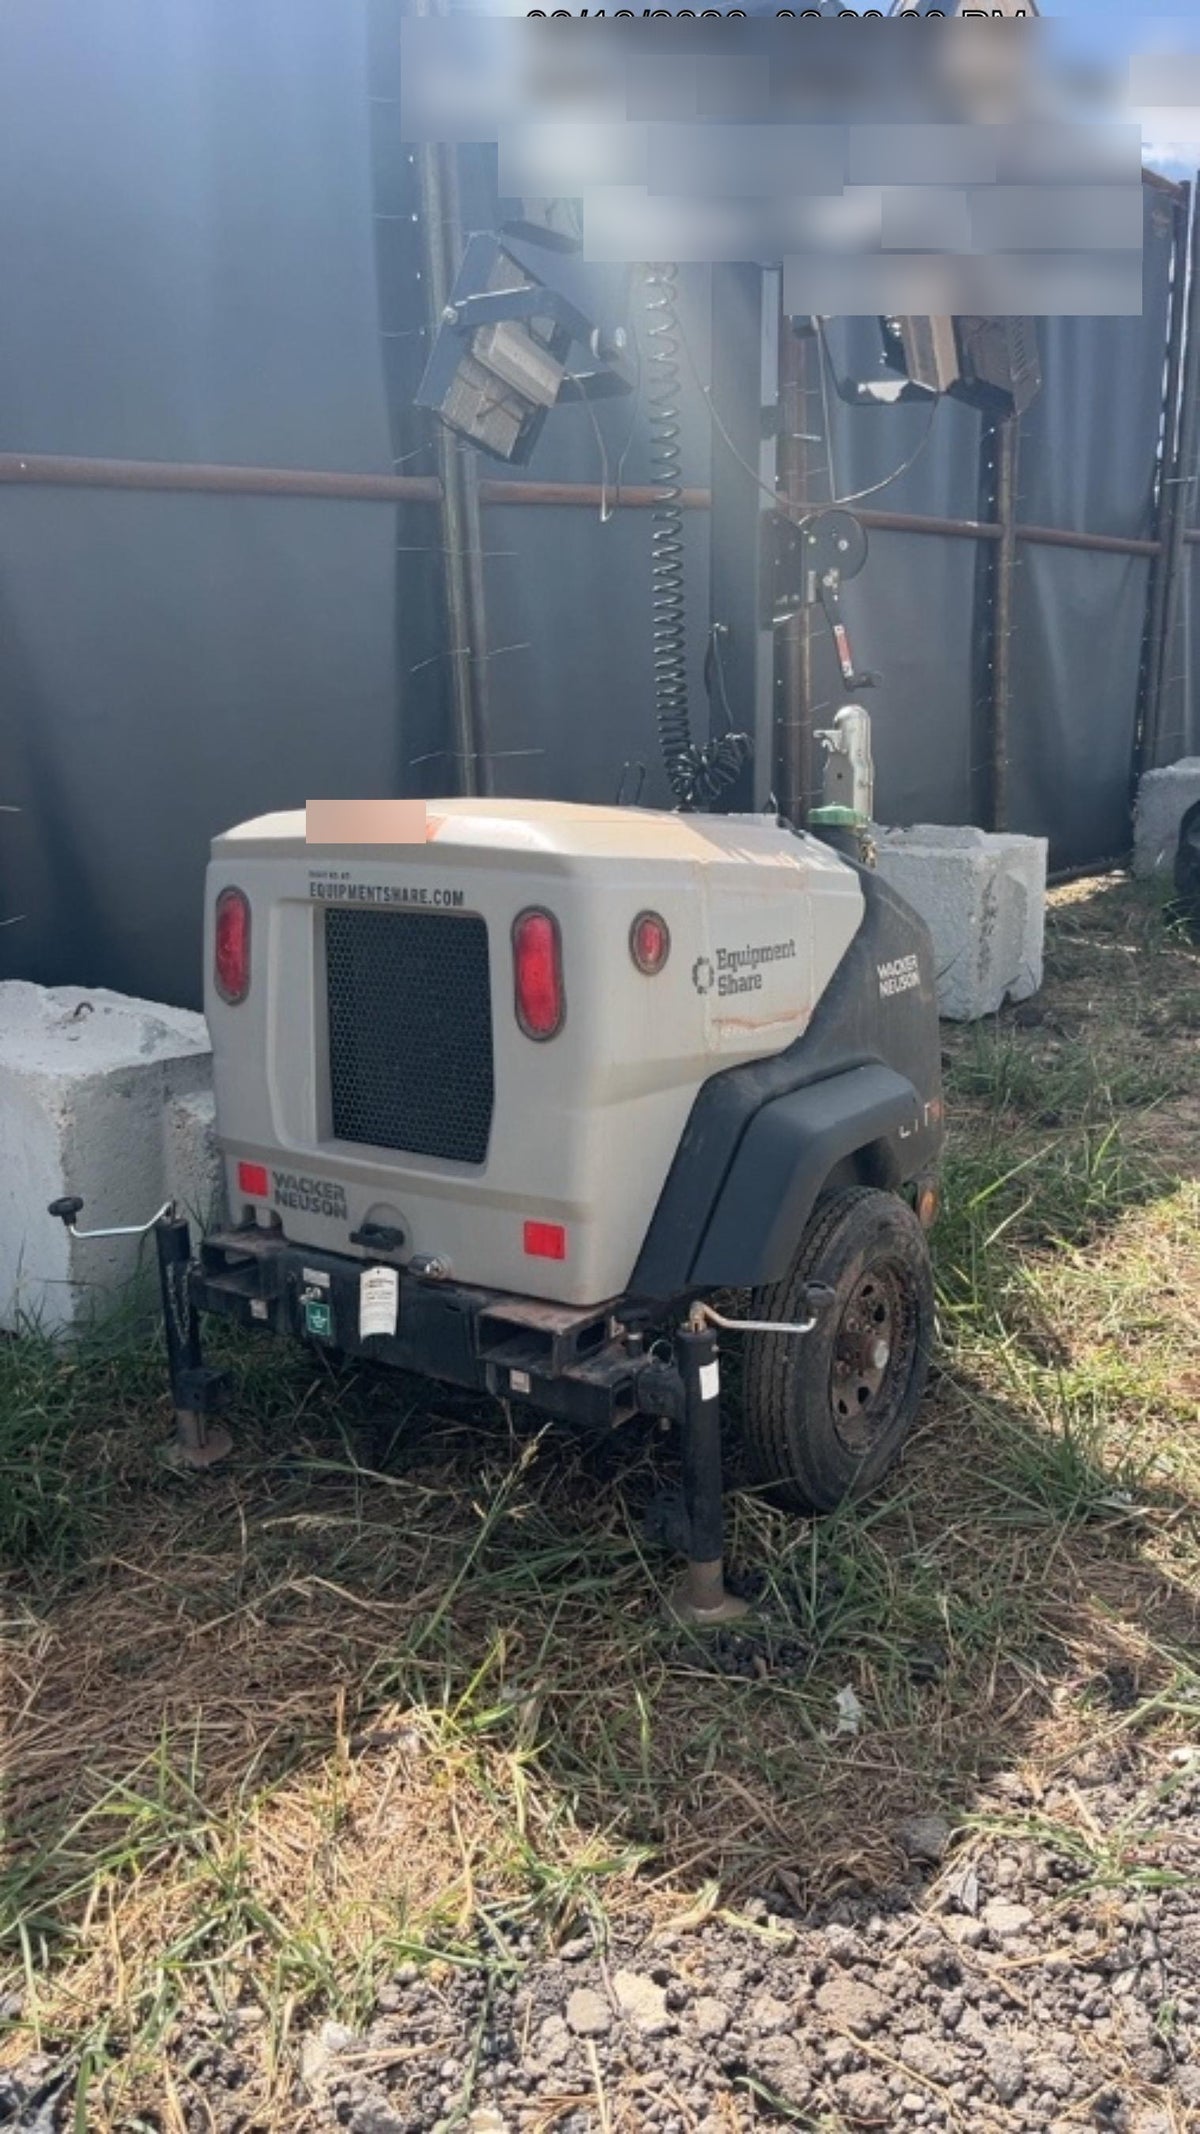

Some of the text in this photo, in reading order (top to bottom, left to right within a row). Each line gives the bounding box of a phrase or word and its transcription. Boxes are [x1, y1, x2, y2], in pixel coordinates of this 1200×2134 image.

[310, 882, 464, 906] EQUIPMENTSHARE.COM
[716, 938, 797, 974] Equipment
[877, 953, 919, 980] WACKER
[718, 974, 763, 997] Share
[879, 971, 922, 1000] NEUSON
[272, 1171, 345, 1203] WACKER
[274, 1188, 348, 1221] NEUSON
